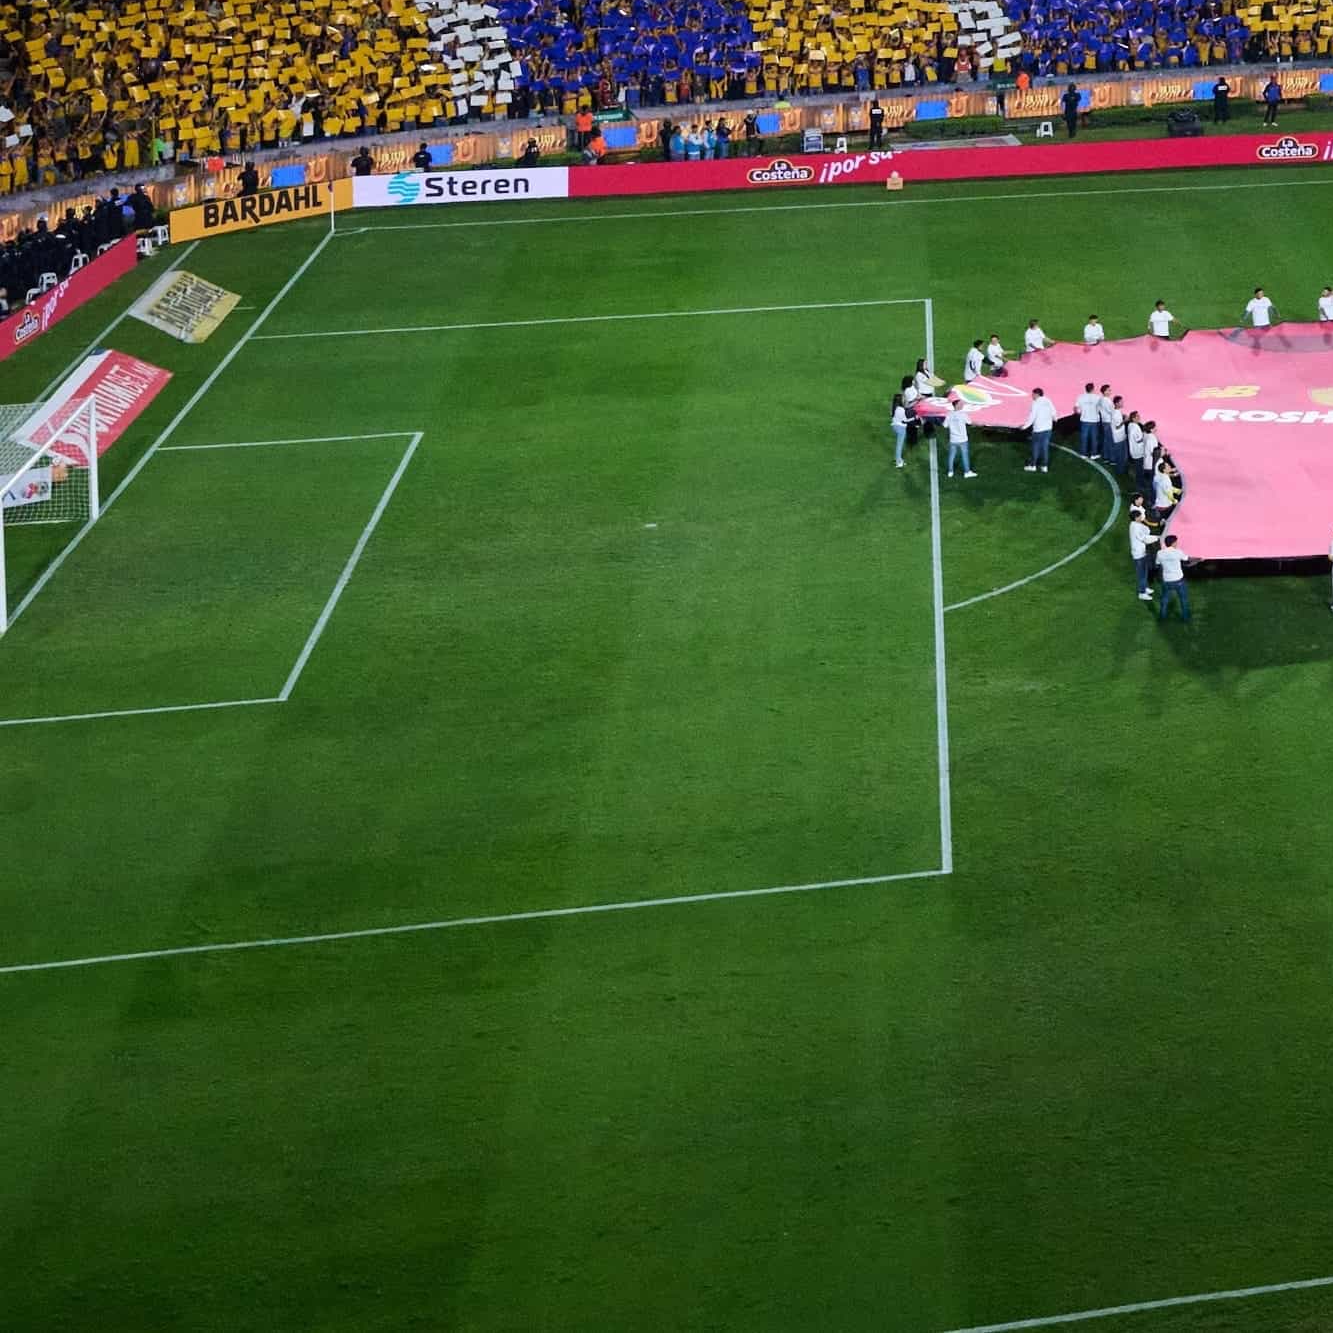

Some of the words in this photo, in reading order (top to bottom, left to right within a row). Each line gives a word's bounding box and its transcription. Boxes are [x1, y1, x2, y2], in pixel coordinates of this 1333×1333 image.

[1282, 139, 1293, 147] La
[774, 162, 787, 171] La
[425, 176, 529, 198] Steren
[204, 188, 322, 228] BARDAHL
